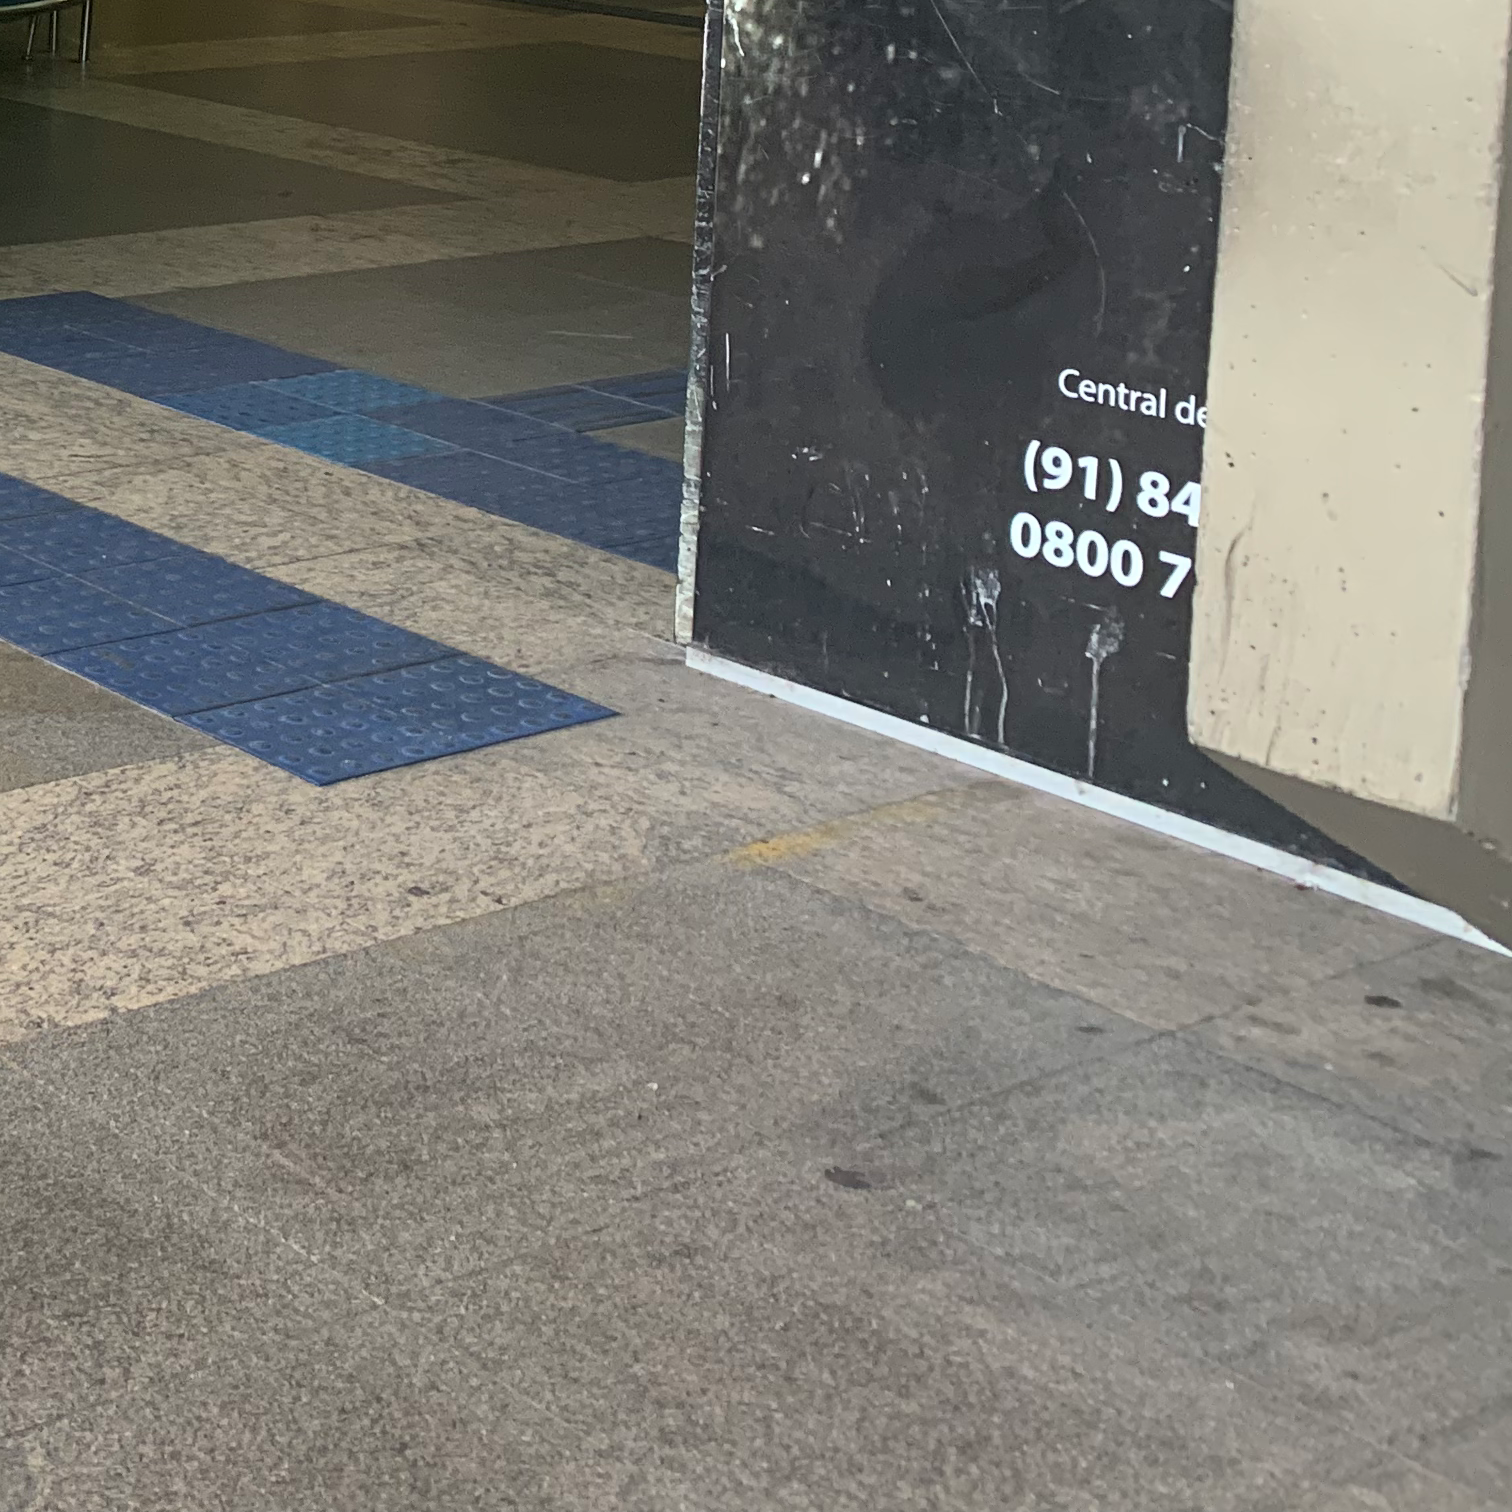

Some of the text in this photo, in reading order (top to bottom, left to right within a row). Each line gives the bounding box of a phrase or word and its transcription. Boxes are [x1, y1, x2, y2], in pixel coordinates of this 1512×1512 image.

[1058, 368, 1208, 428] Central de
[1023, 439, 1202, 527] (91) 84
[1010, 512, 1192, 598] 0800 7
